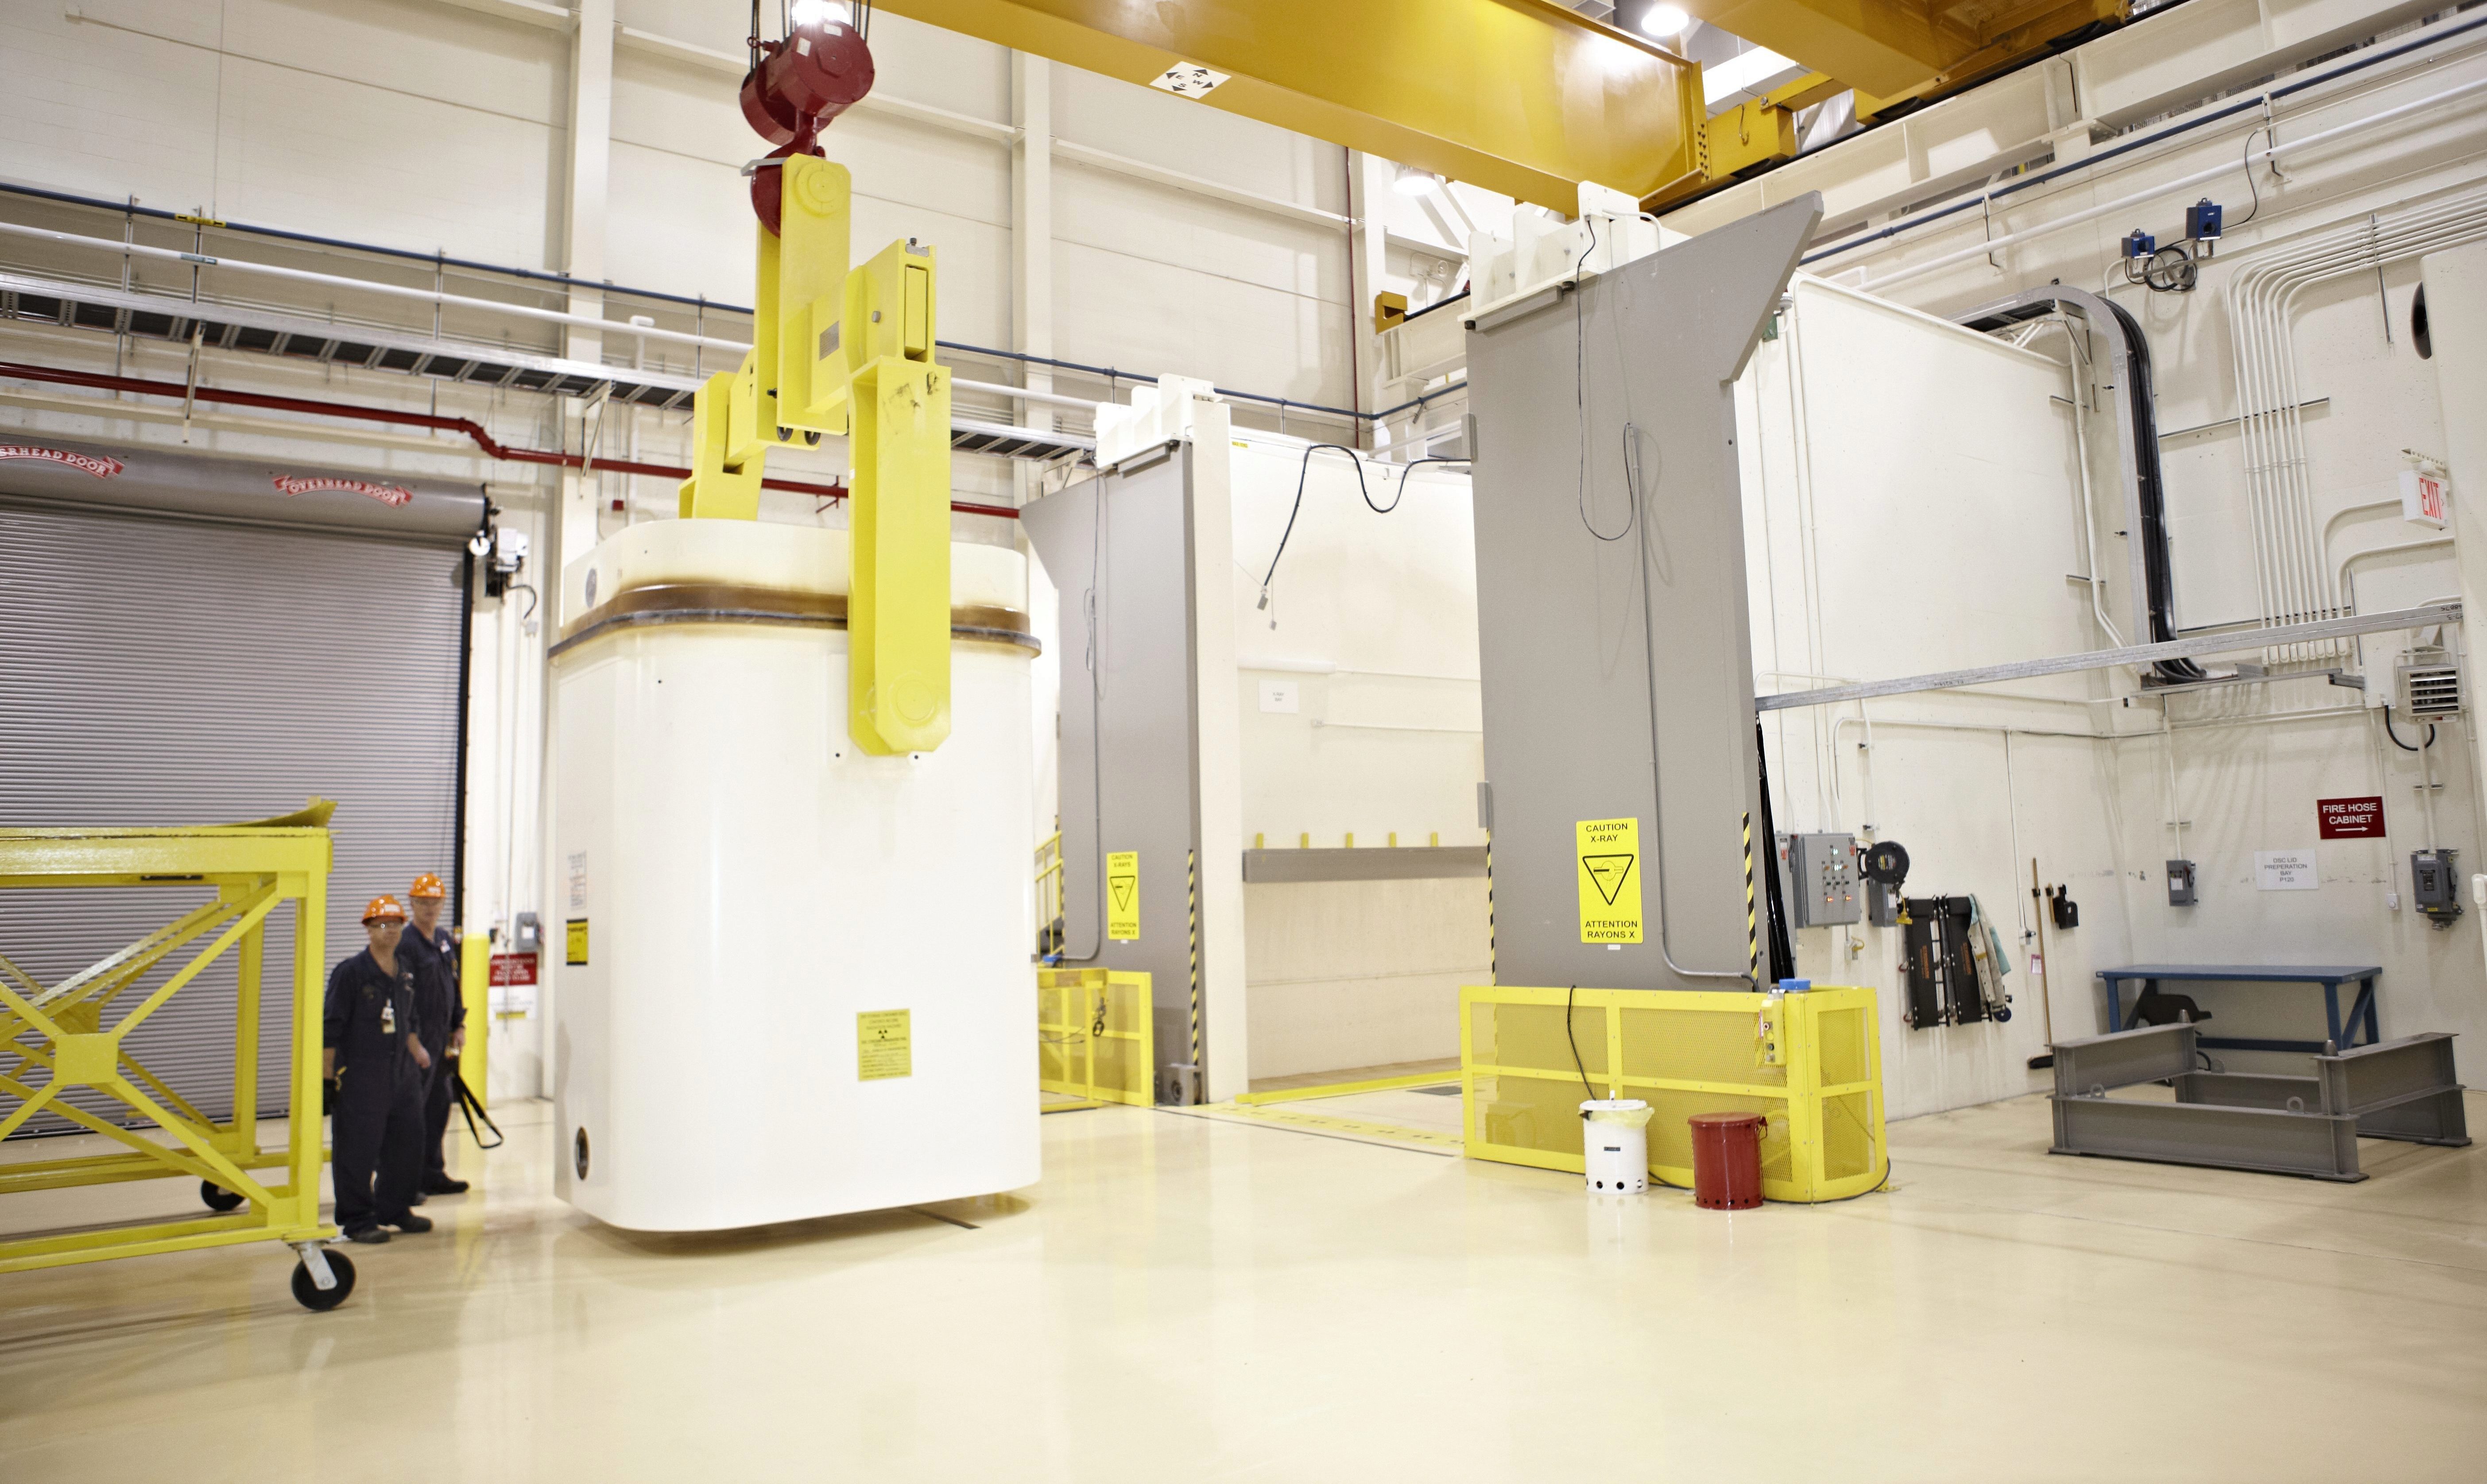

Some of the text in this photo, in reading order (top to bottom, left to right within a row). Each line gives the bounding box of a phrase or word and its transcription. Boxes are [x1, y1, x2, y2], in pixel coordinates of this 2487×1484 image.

[66, 453, 107, 476] DOOR
[2418, 477, 2442, 520] EXIT
[2323, 802, 2378, 813] FIRE HOSE
[2328, 814, 2373, 824] CABINET
[1586, 823, 1628, 832] CAUTION
[1585, 920, 1638, 928] ATTENTION
